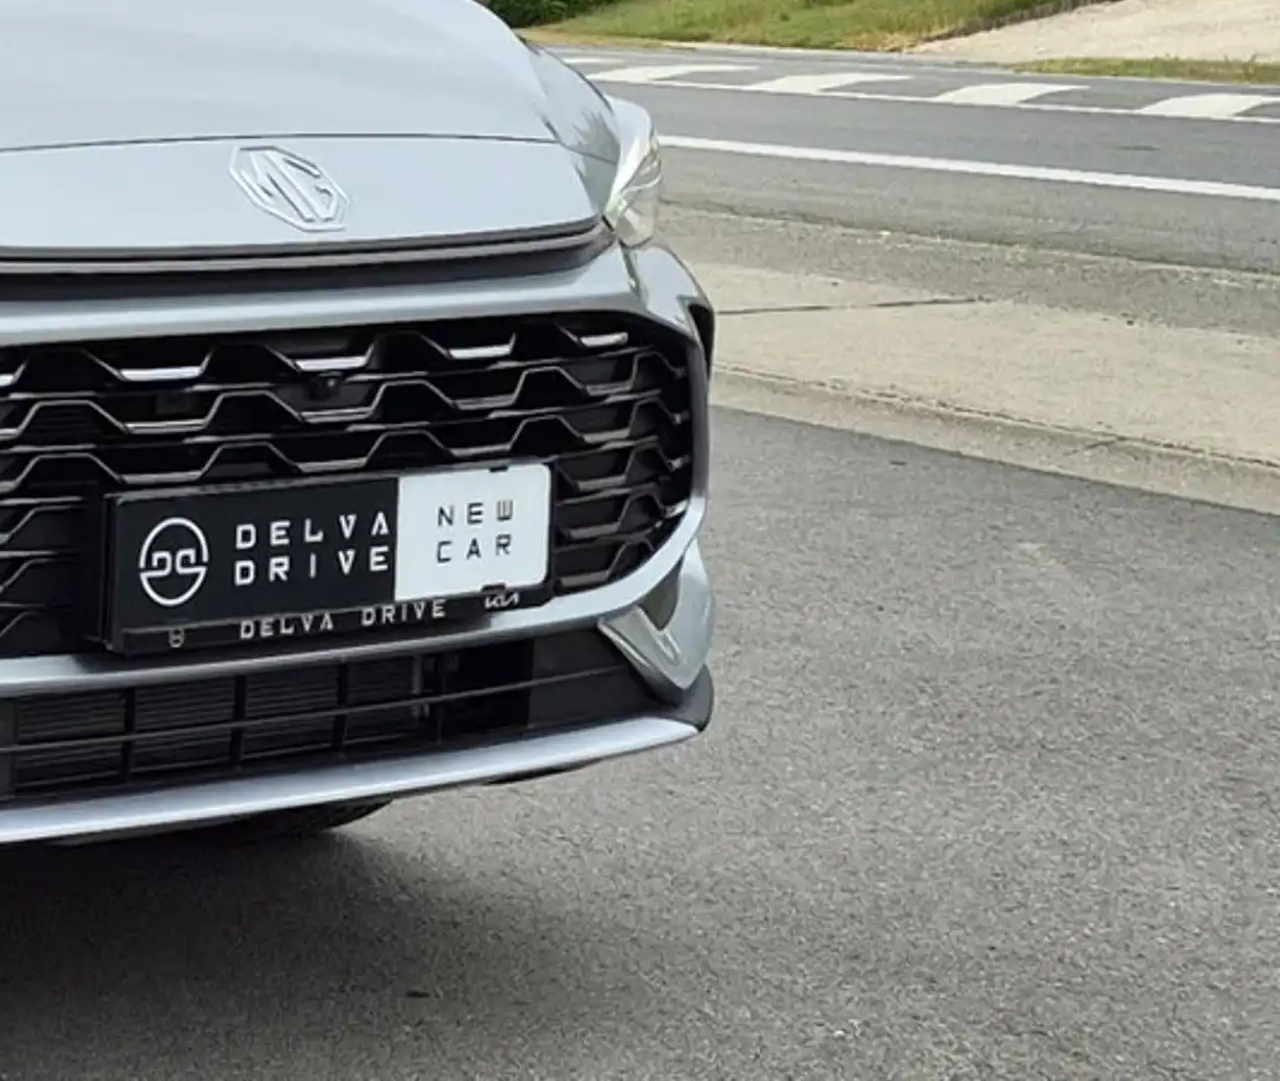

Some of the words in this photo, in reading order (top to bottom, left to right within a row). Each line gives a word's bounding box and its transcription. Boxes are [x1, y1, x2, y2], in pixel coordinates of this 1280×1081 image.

[236, 511, 389, 549] DELVA
[437, 499, 514, 526] NEW
[234, 546, 389, 586] DRIVE
[436, 533, 512, 564] CAR
[240, 612, 334, 640] DELVA
[361, 598, 446, 627] DRIVE
